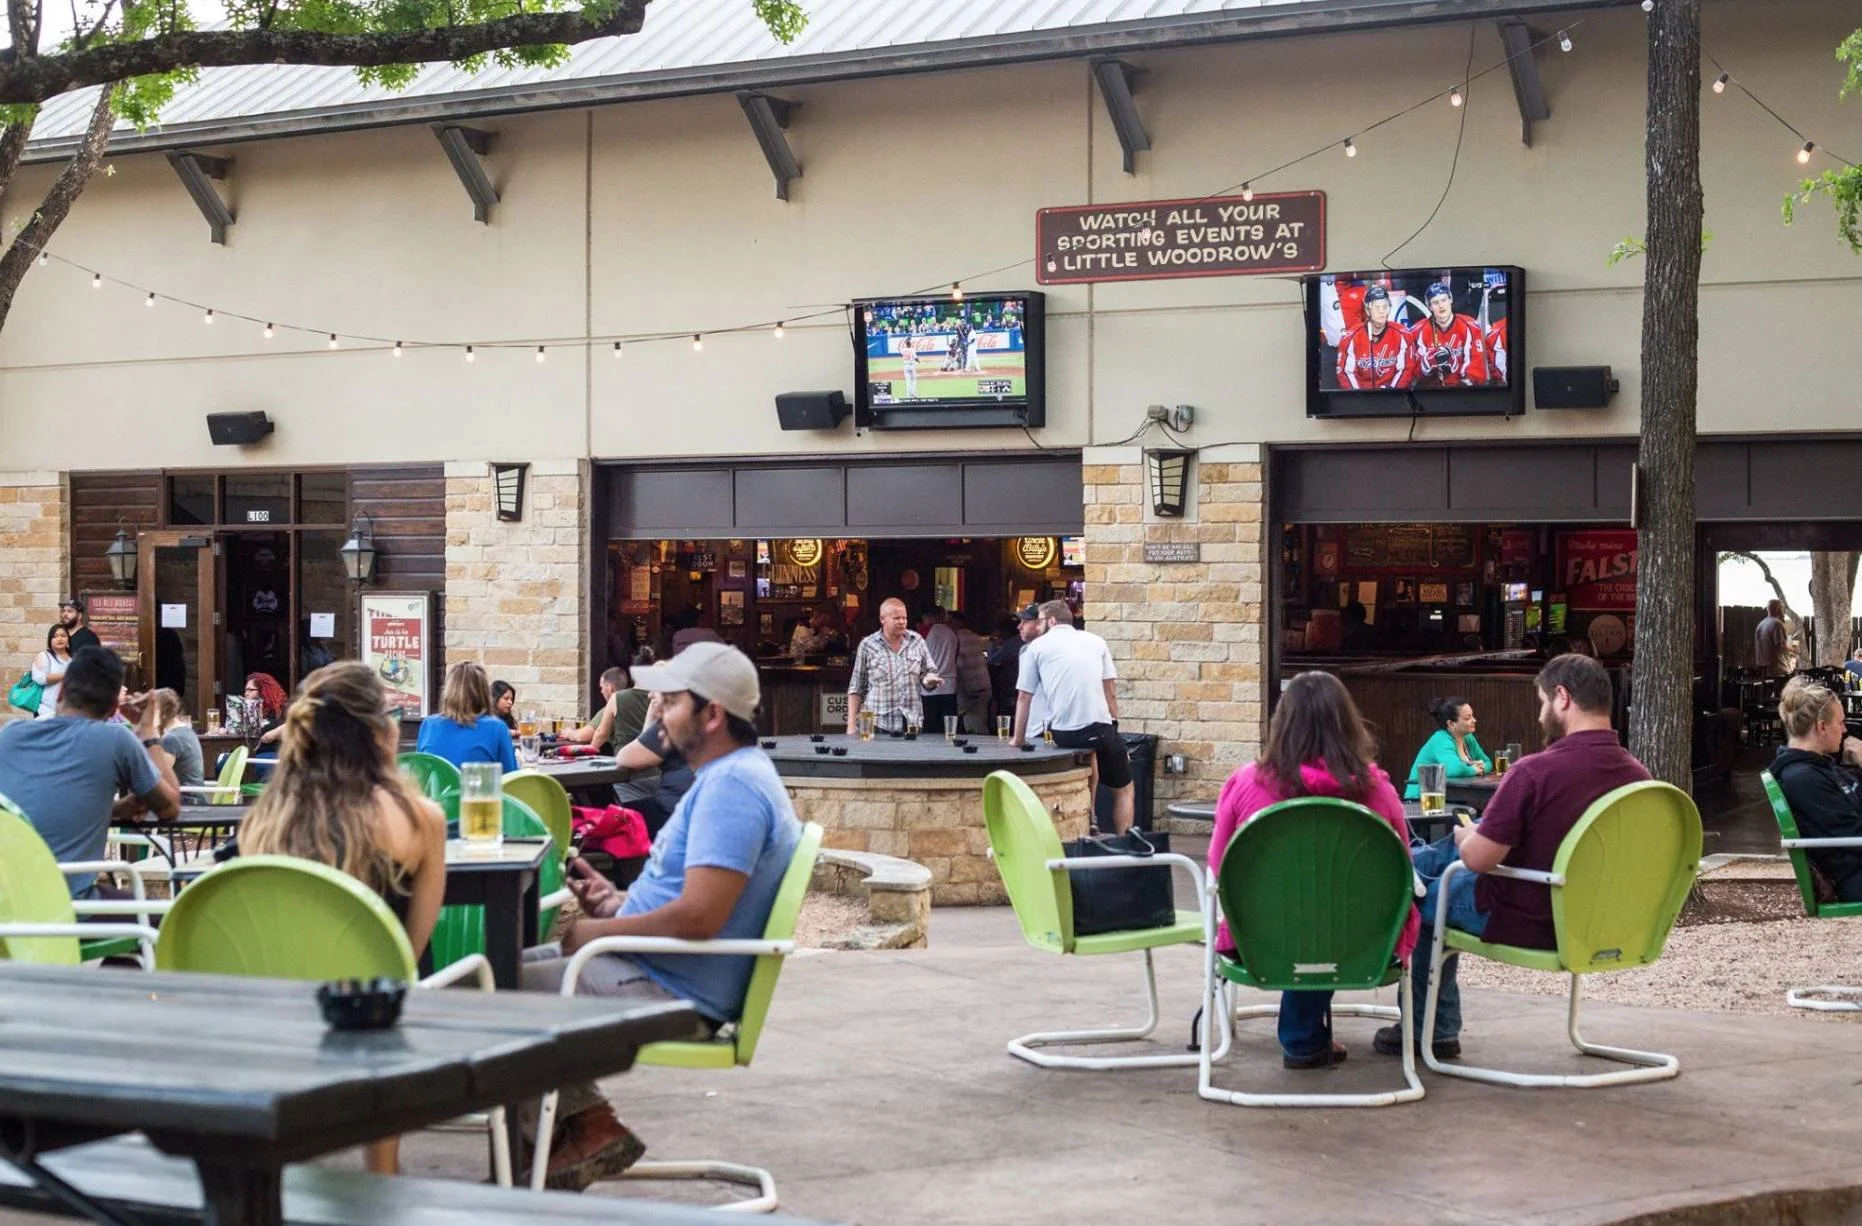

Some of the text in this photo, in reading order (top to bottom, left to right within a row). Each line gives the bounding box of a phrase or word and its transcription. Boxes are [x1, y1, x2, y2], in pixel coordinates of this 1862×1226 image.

[1080, 204, 1281, 231] WATCH ALL YOUR
[1057, 222, 1305, 252] SPORTING EVENTS AT
[1063, 243, 1299, 271] LITTLE WOODROW'S
[372, 636, 420, 649] TURTLE
